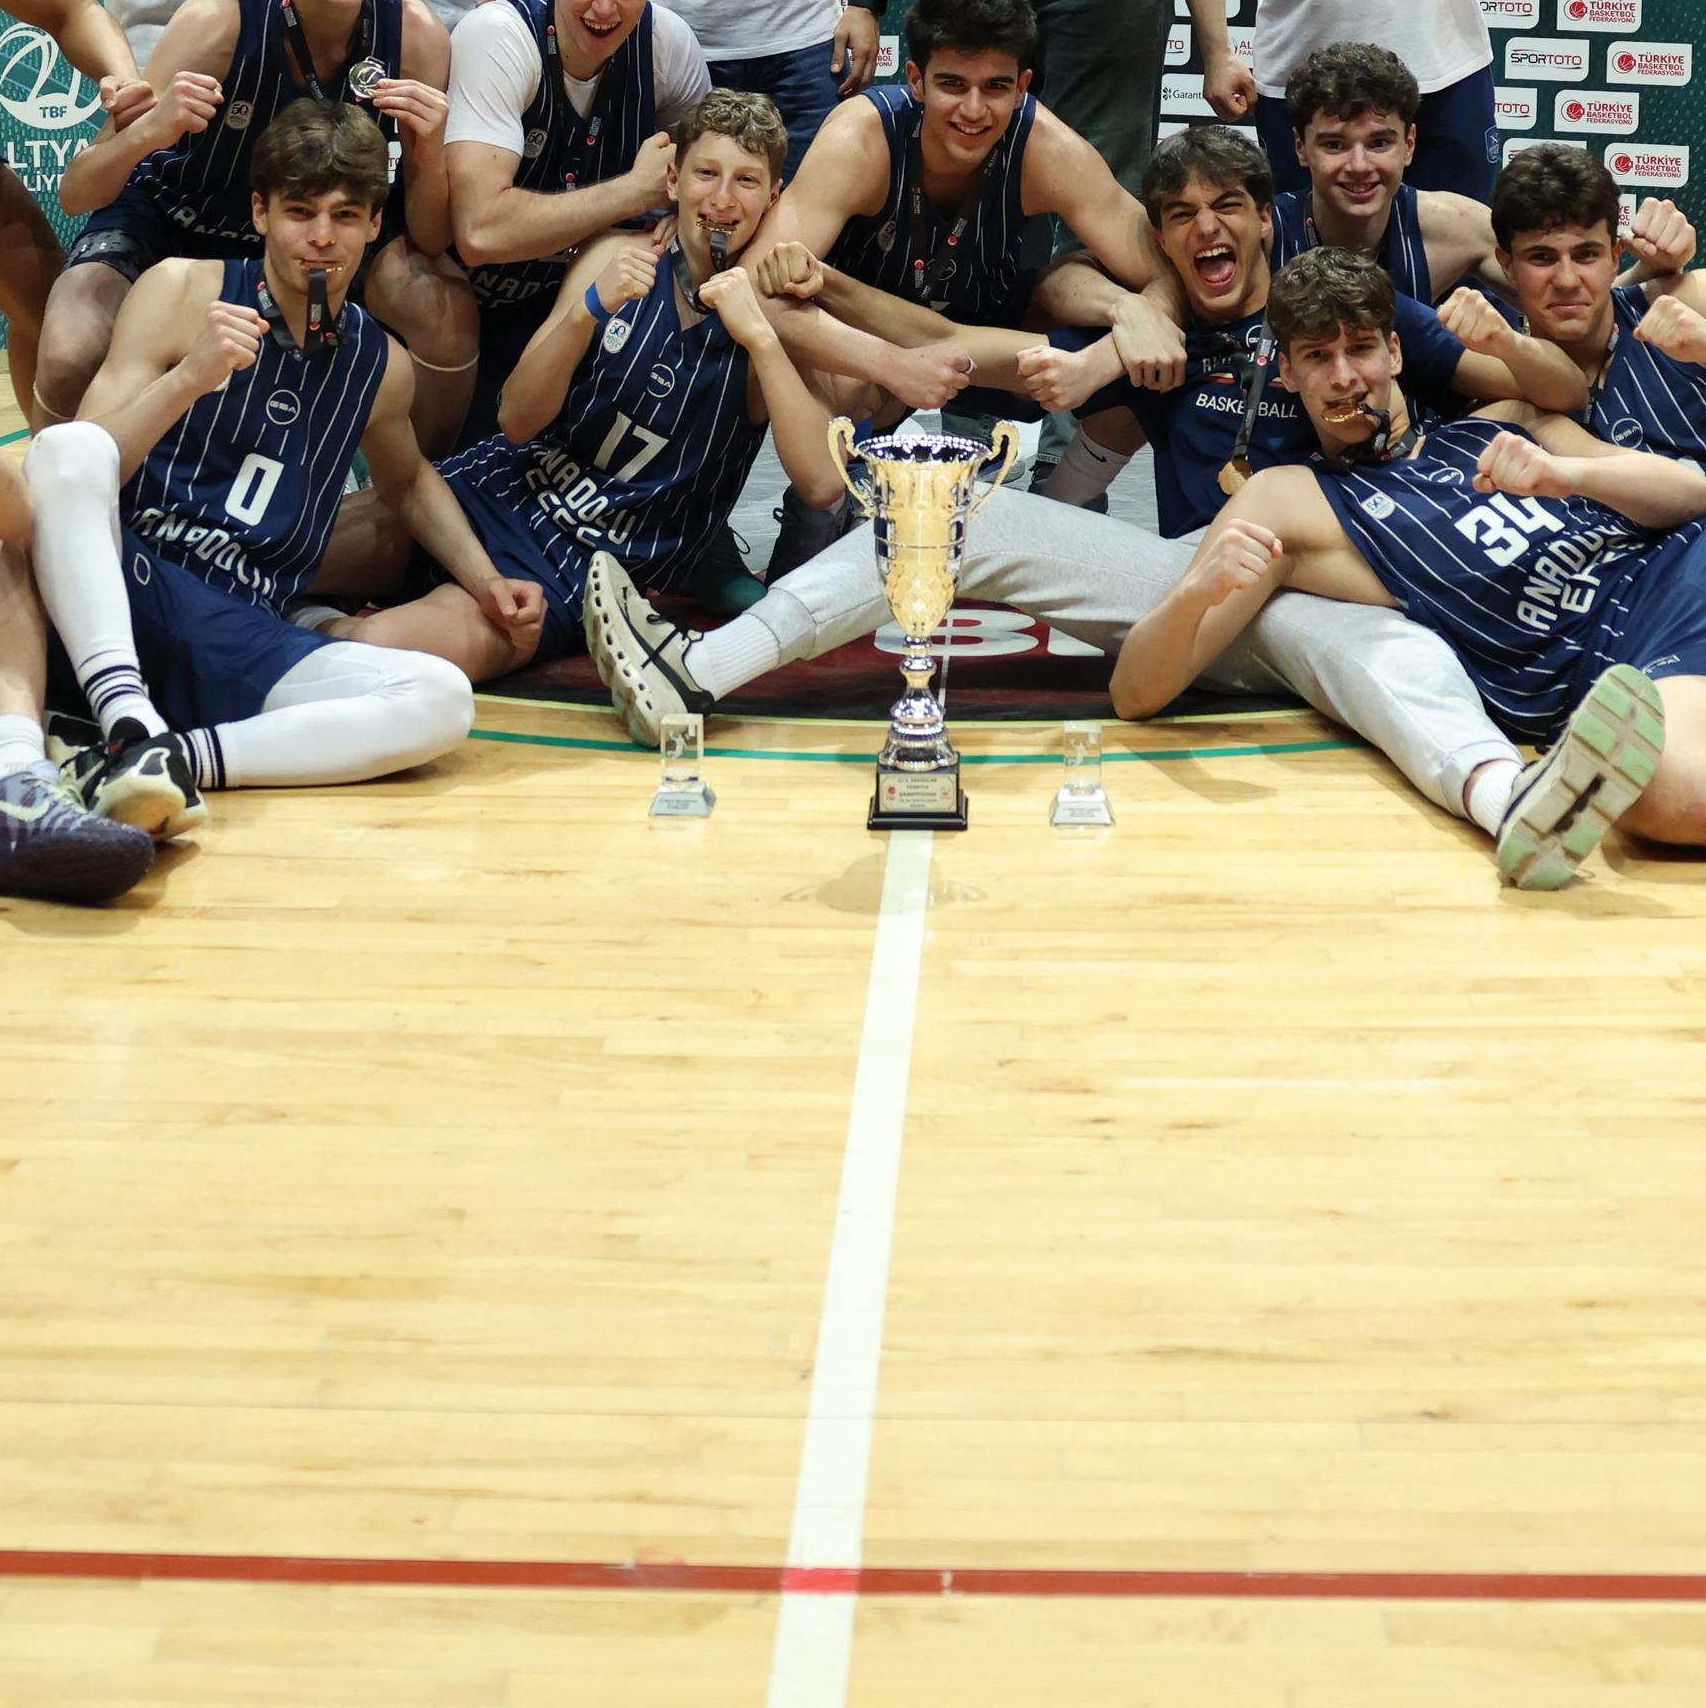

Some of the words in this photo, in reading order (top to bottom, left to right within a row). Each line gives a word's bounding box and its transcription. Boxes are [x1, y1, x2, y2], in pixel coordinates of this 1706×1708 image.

[1590, 0, 1636, 11] TÜRKİYE
[1589, 10, 1635, 18] BASKETBOL
[1510, 52, 1582, 66] SPORTOTO
[1638, 52, 1684, 64] TÜRKİYE
[1638, 63, 1684, 71] BASKETBOL
[39, 105, 68, 119] TBF
[1587, 101, 1633, 113] TÜRKİYE
[1586, 111, 1632, 120] BASKETBOL
[1635, 154, 1681, 166] TÜRKİYE
[1635, 164, 1681, 173] BASKETBOL
[1195, 392, 1299, 419] BASKEBALL
[594, 410, 670, 484] 17
[224, 452, 285, 527] 0
[1454, 492, 1566, 567] 34
